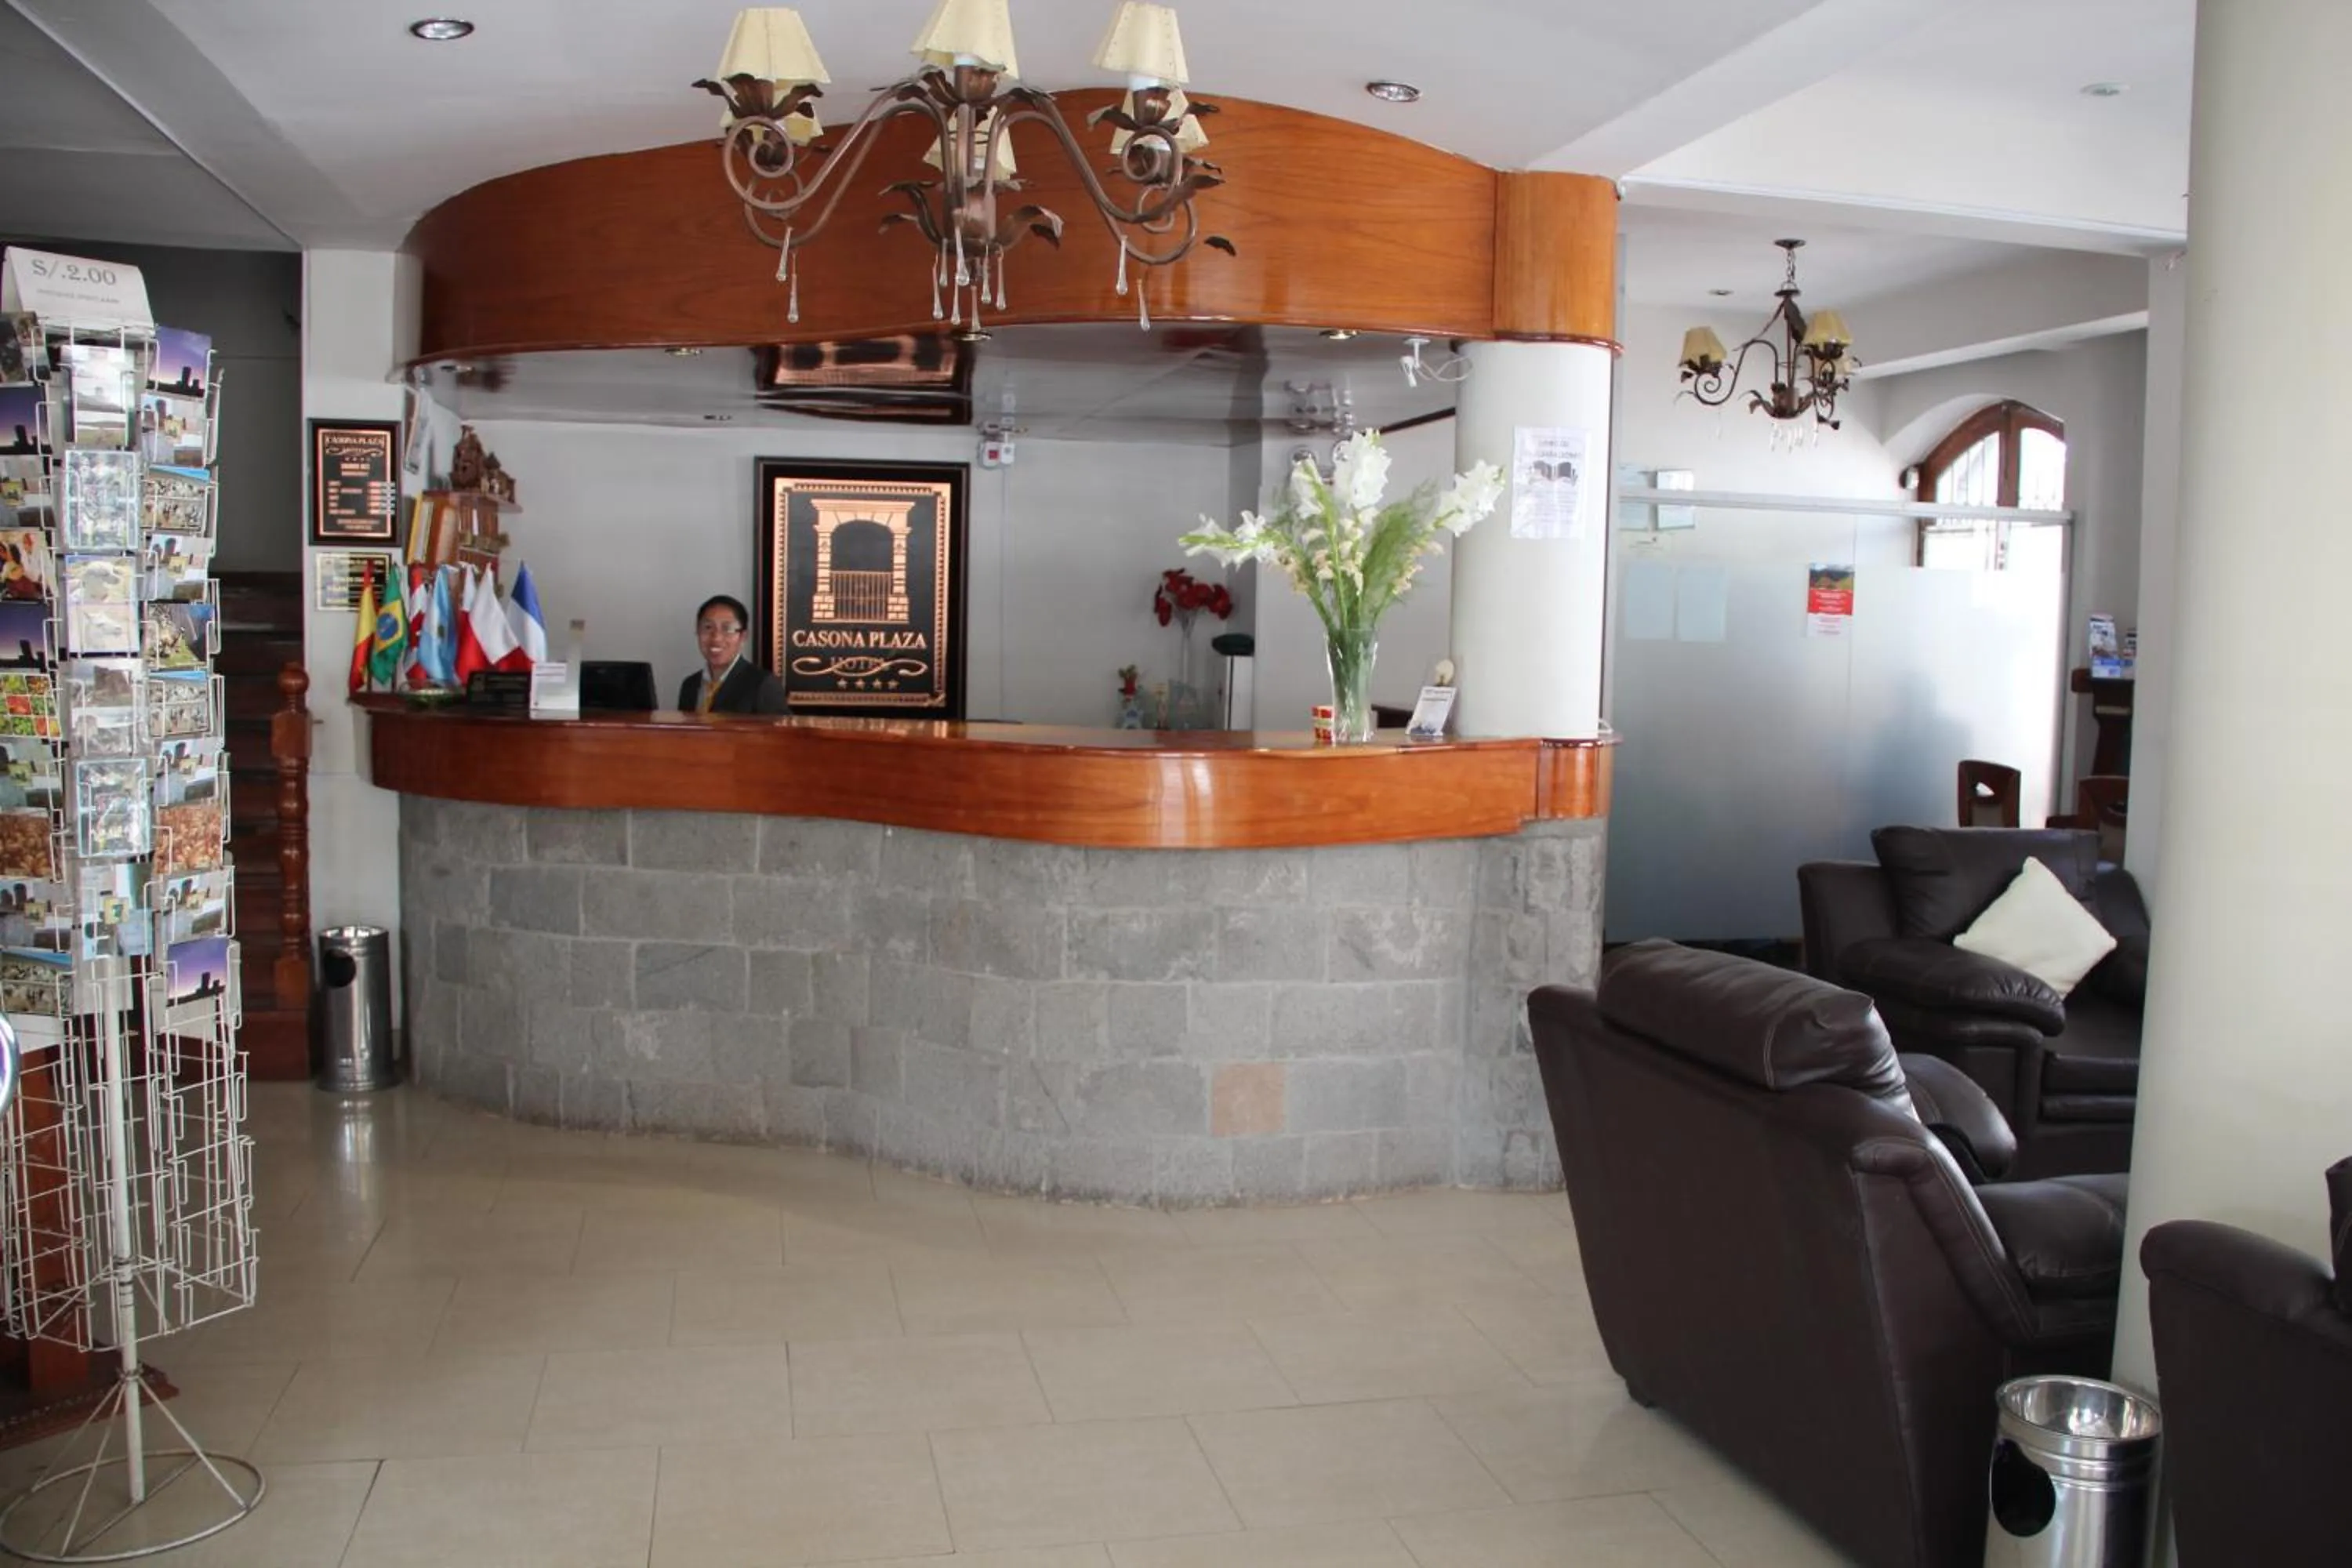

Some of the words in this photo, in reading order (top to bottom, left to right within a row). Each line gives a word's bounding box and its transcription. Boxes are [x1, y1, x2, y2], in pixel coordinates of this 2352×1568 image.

[31, 258, 117, 285] S/.2.00
[792, 630, 866, 648] CASONA
[869, 631, 927, 649] PLAZA
